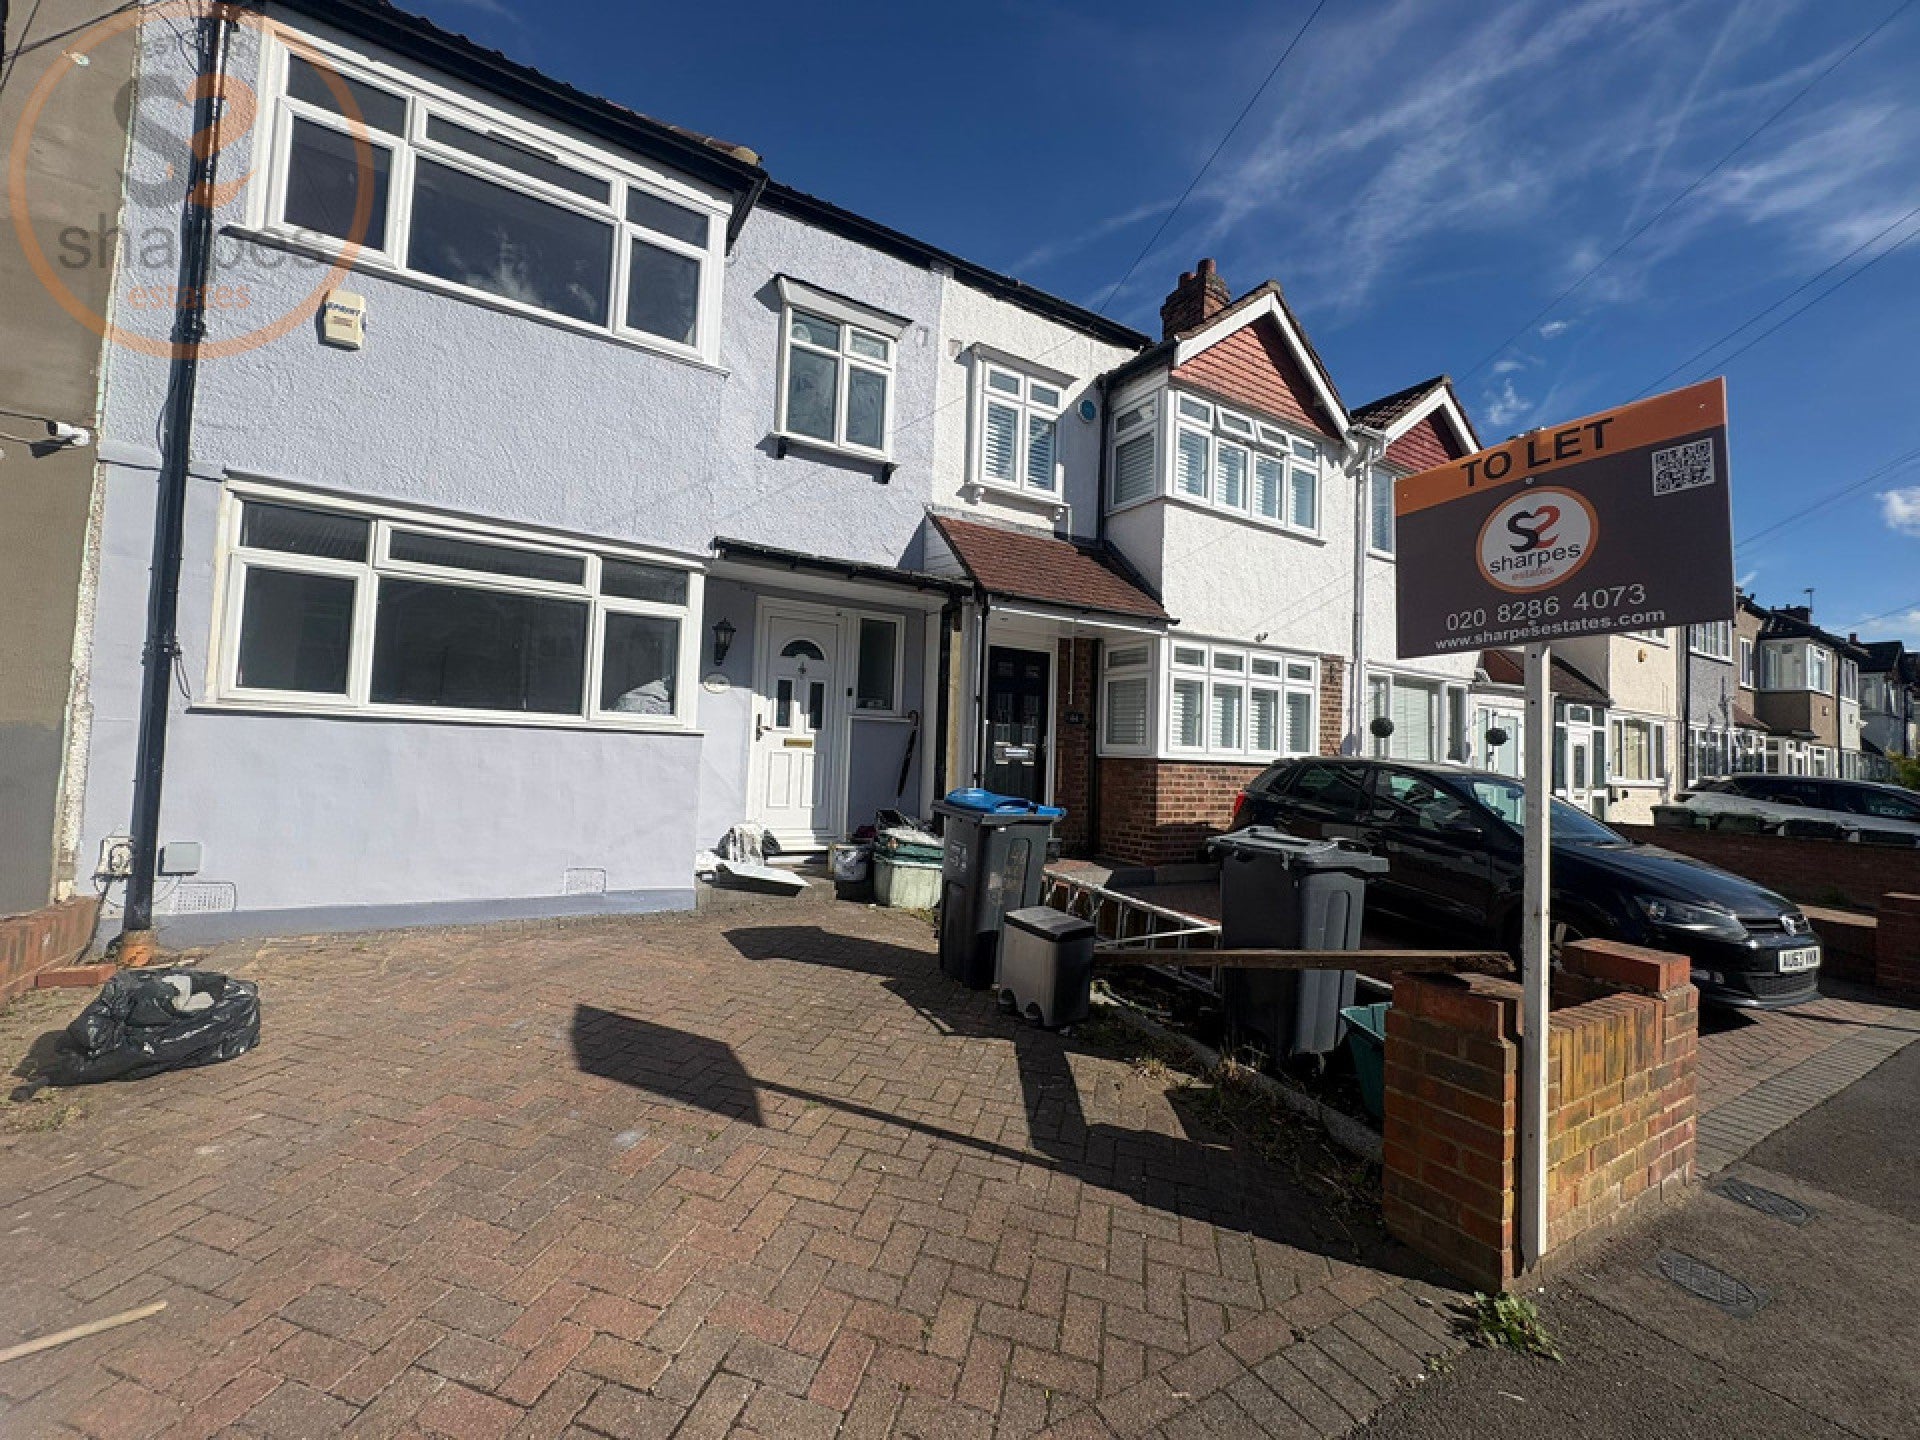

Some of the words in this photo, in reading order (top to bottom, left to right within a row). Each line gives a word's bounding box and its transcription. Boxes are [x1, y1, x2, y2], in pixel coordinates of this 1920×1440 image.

[1461, 451, 1511, 486] TO
[1528, 417, 1614, 469] LET
[1489, 543, 1581, 574] sharpes
[1511, 566, 1554, 581] estates
[1446, 608, 1487, 631] 020
[1497, 596, 1560, 623] 8286
[1573, 583, 1646, 611] 4073
[1435, 610, 1665, 650] www.sharpesestates.com
